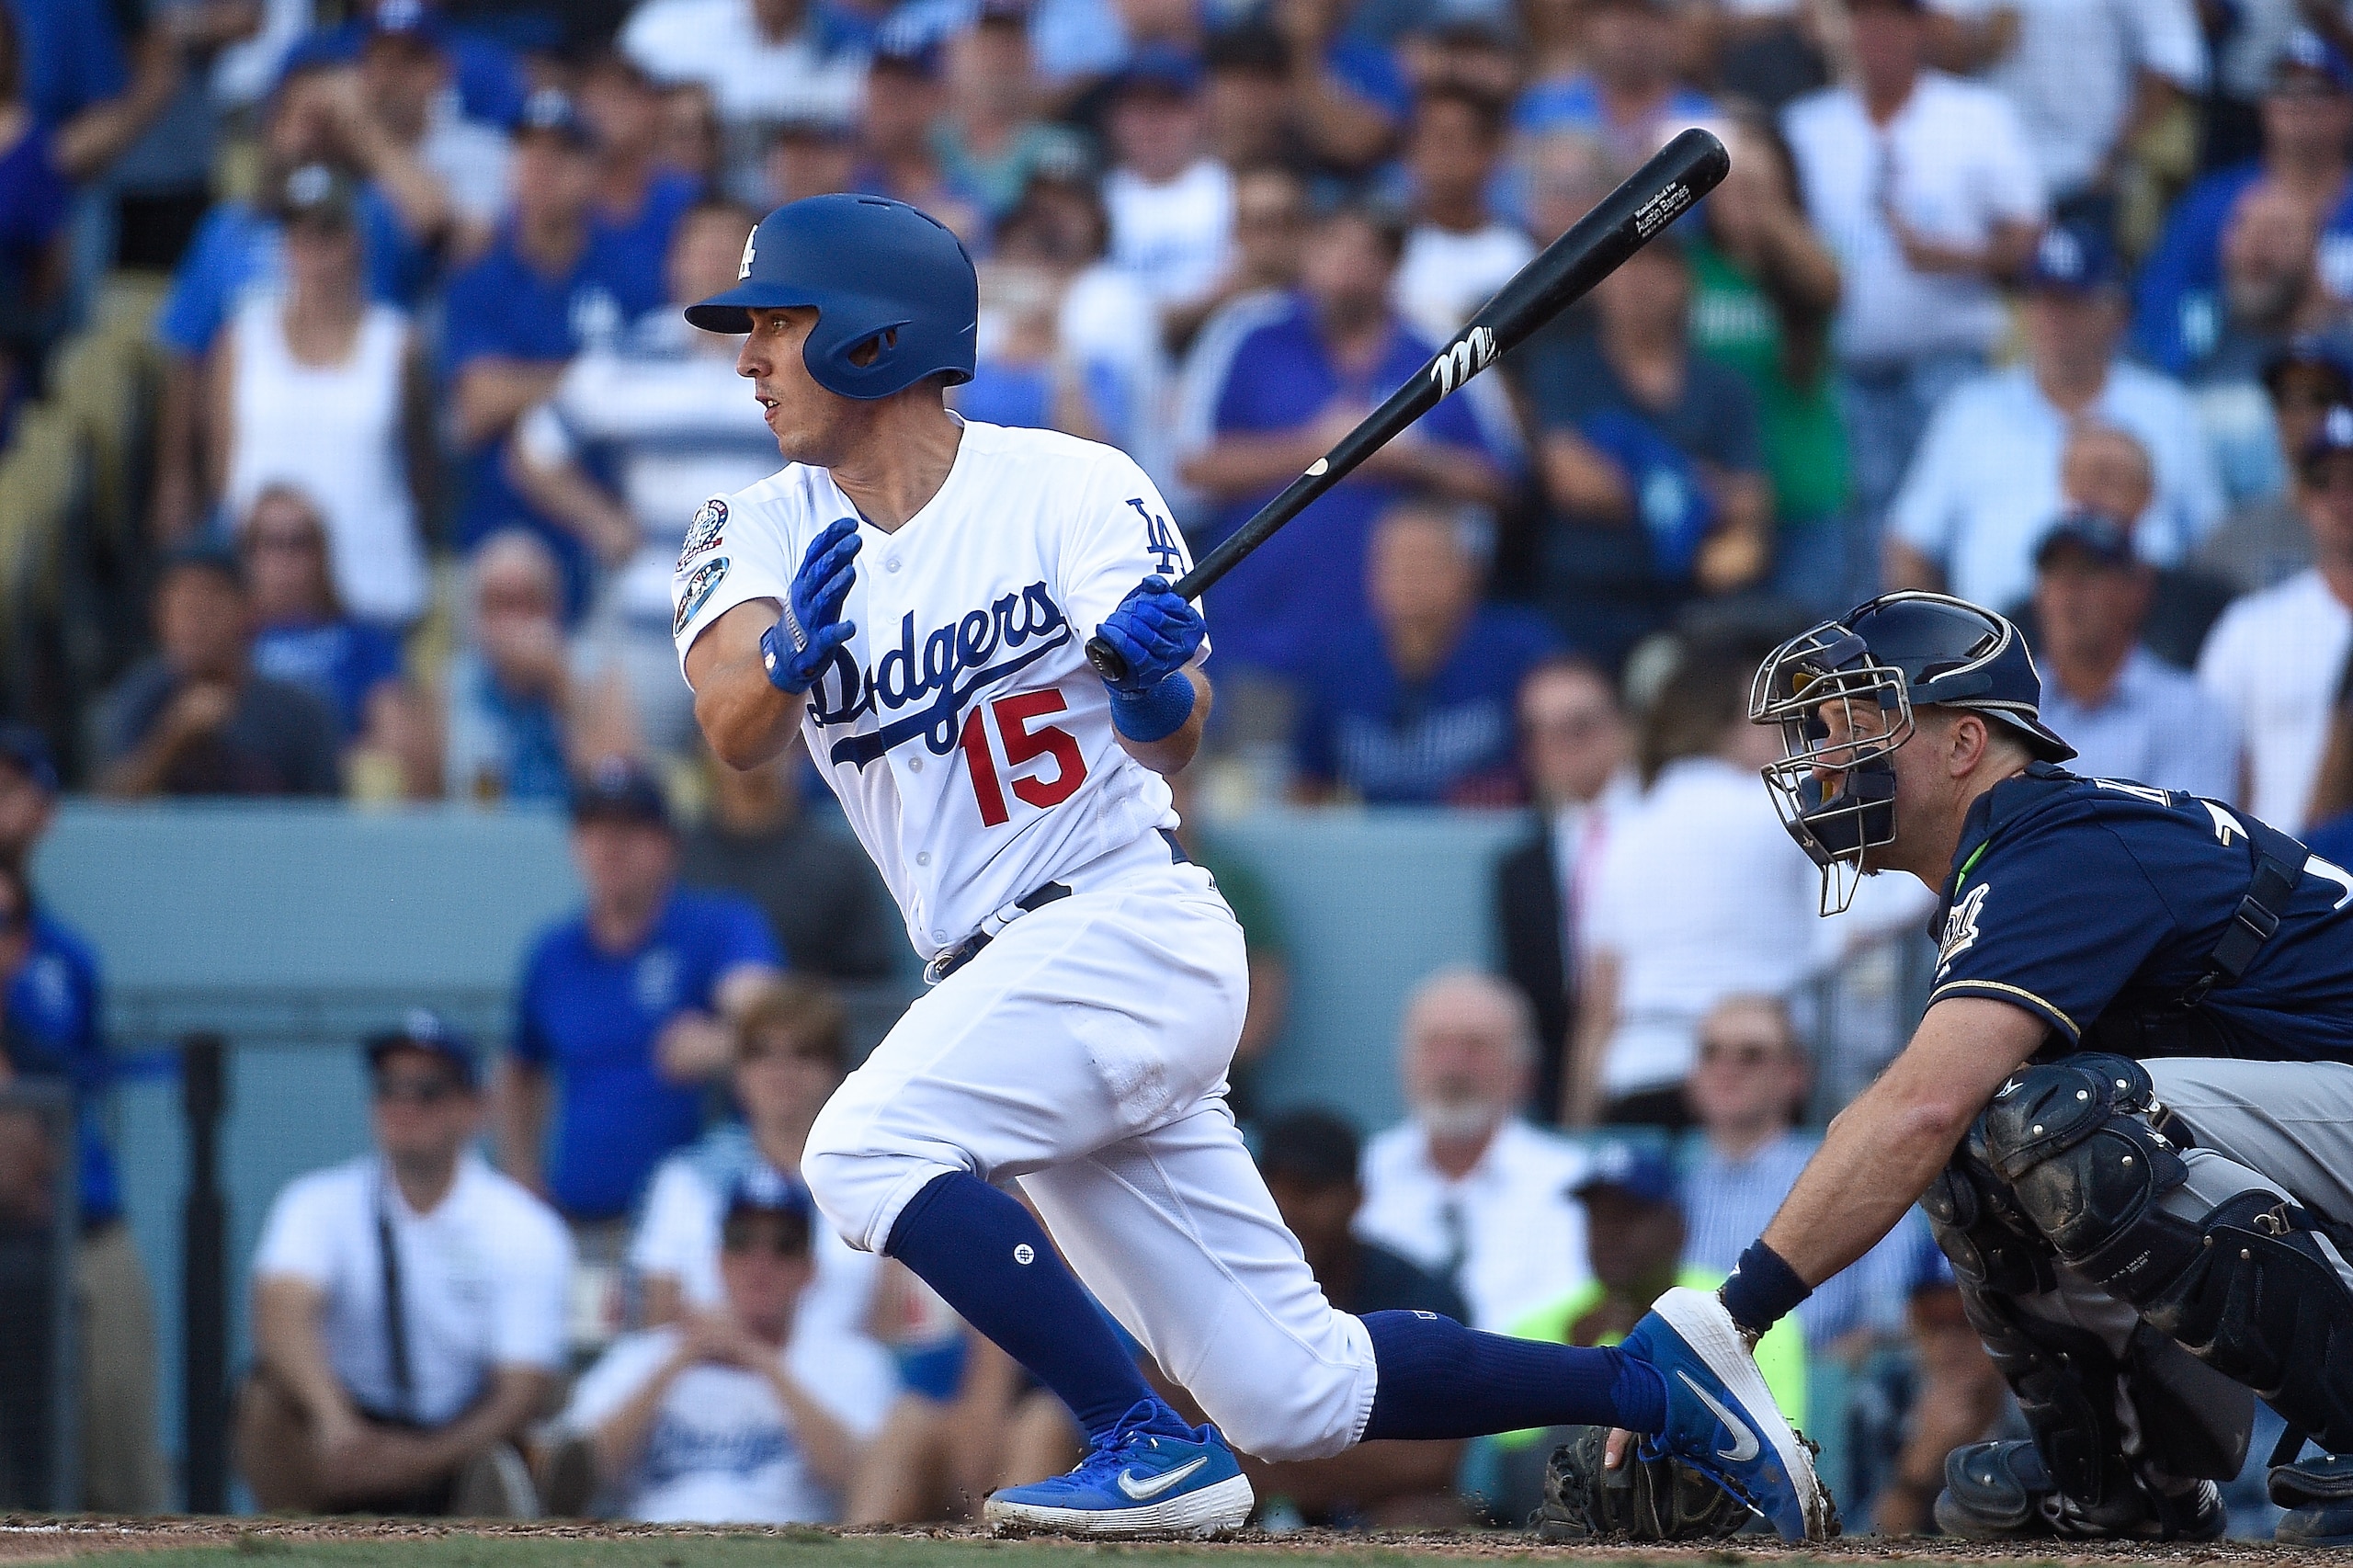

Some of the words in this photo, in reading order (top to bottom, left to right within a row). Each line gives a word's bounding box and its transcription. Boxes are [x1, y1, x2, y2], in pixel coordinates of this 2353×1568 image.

[1636, 208, 1663, 233] Austin
[1659, 185, 1689, 212] Barnes
[1125, 497, 1187, 576] LA
[959, 689, 1087, 827] 15
